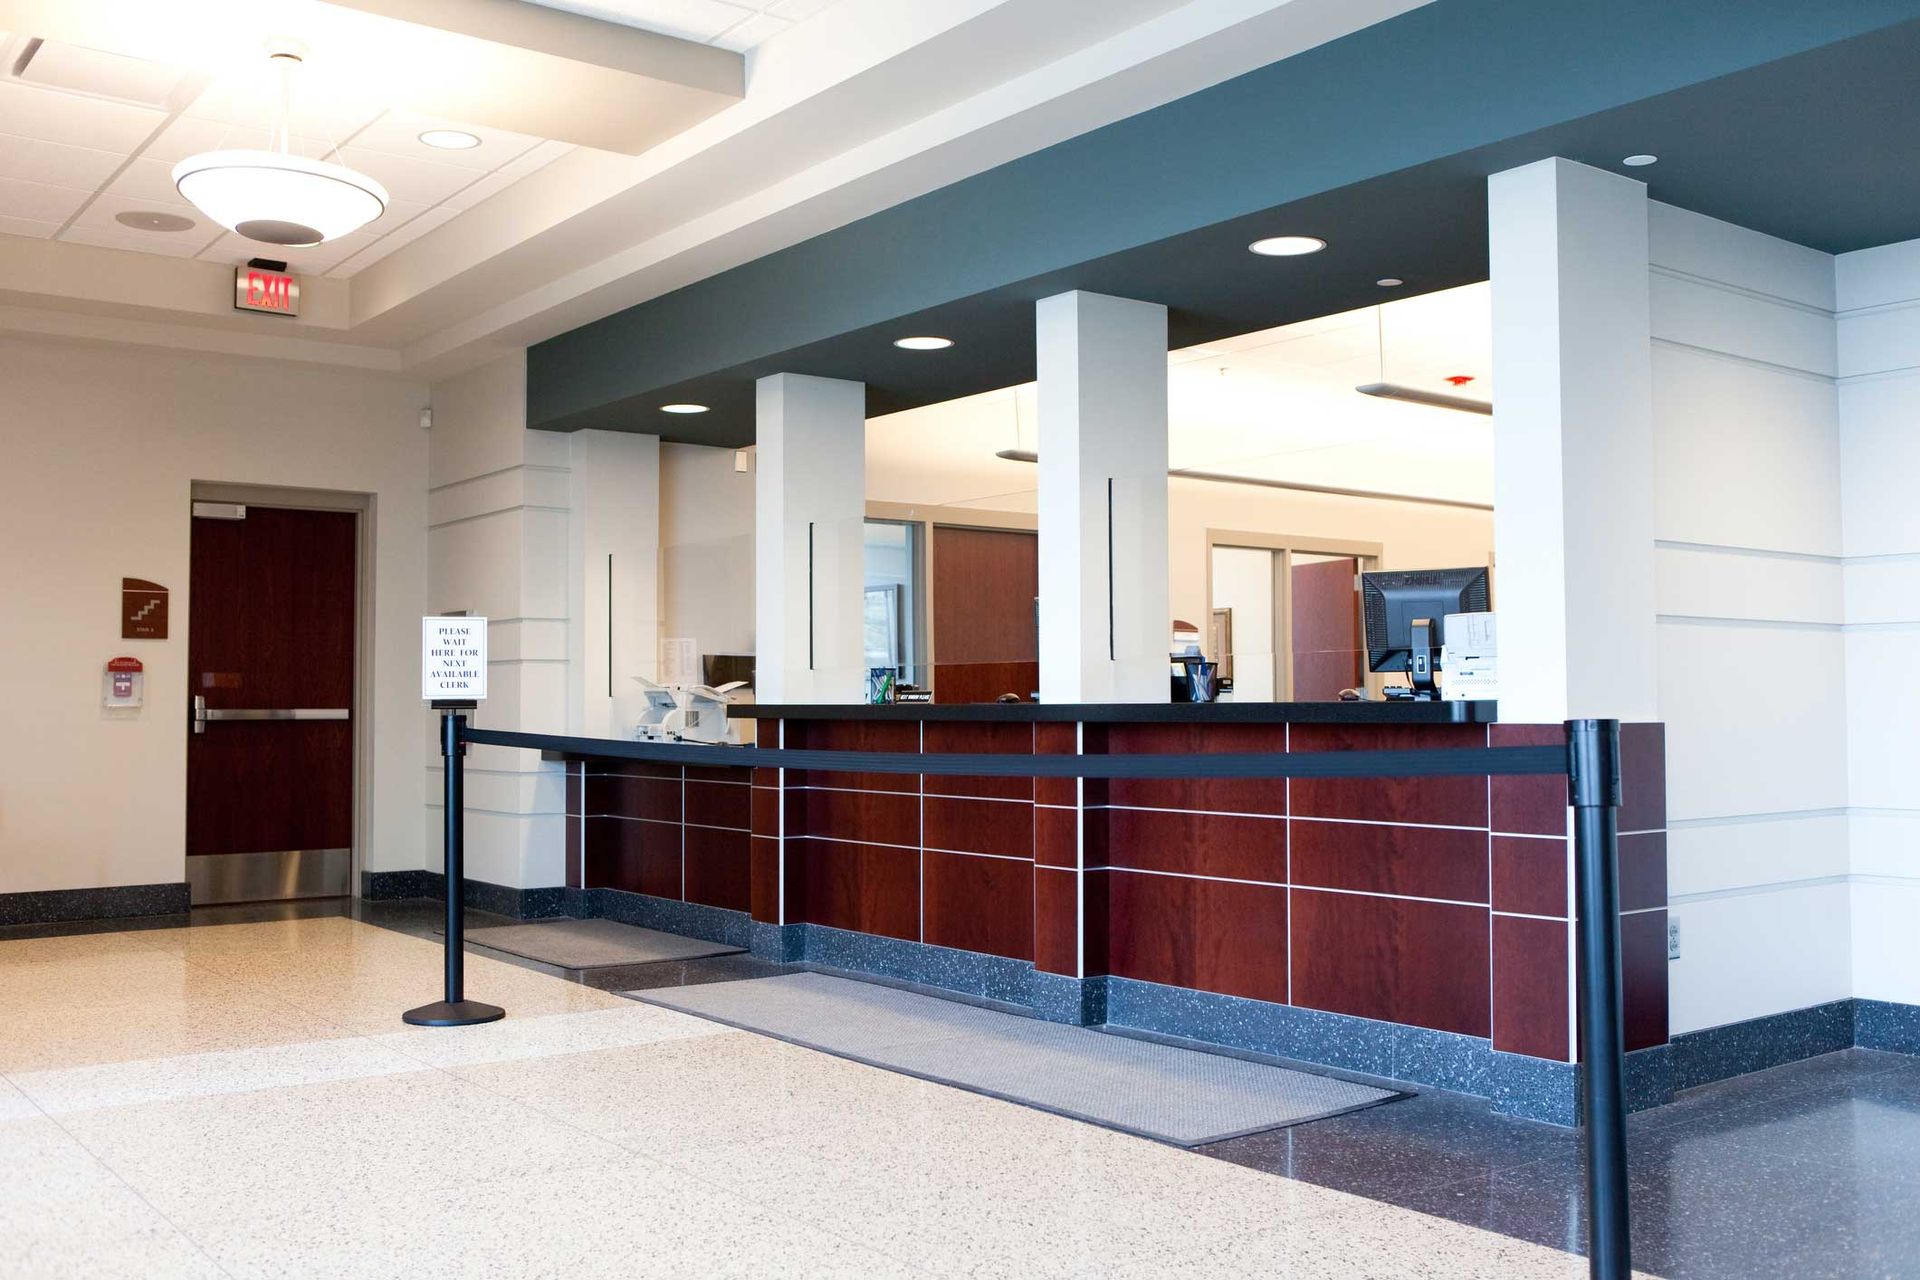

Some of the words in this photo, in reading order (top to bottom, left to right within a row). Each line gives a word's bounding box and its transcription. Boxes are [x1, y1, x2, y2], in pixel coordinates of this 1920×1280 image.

[247, 271, 293, 312] EXIT
[439, 627, 471, 635] PLEASE
[443, 638, 467, 646] WAIT
[431, 649, 456, 657] HERE
[460, 649, 479, 657] FOR
[430, 670, 480, 678] AVAILABLE
[440, 681, 470, 689] CLERK
